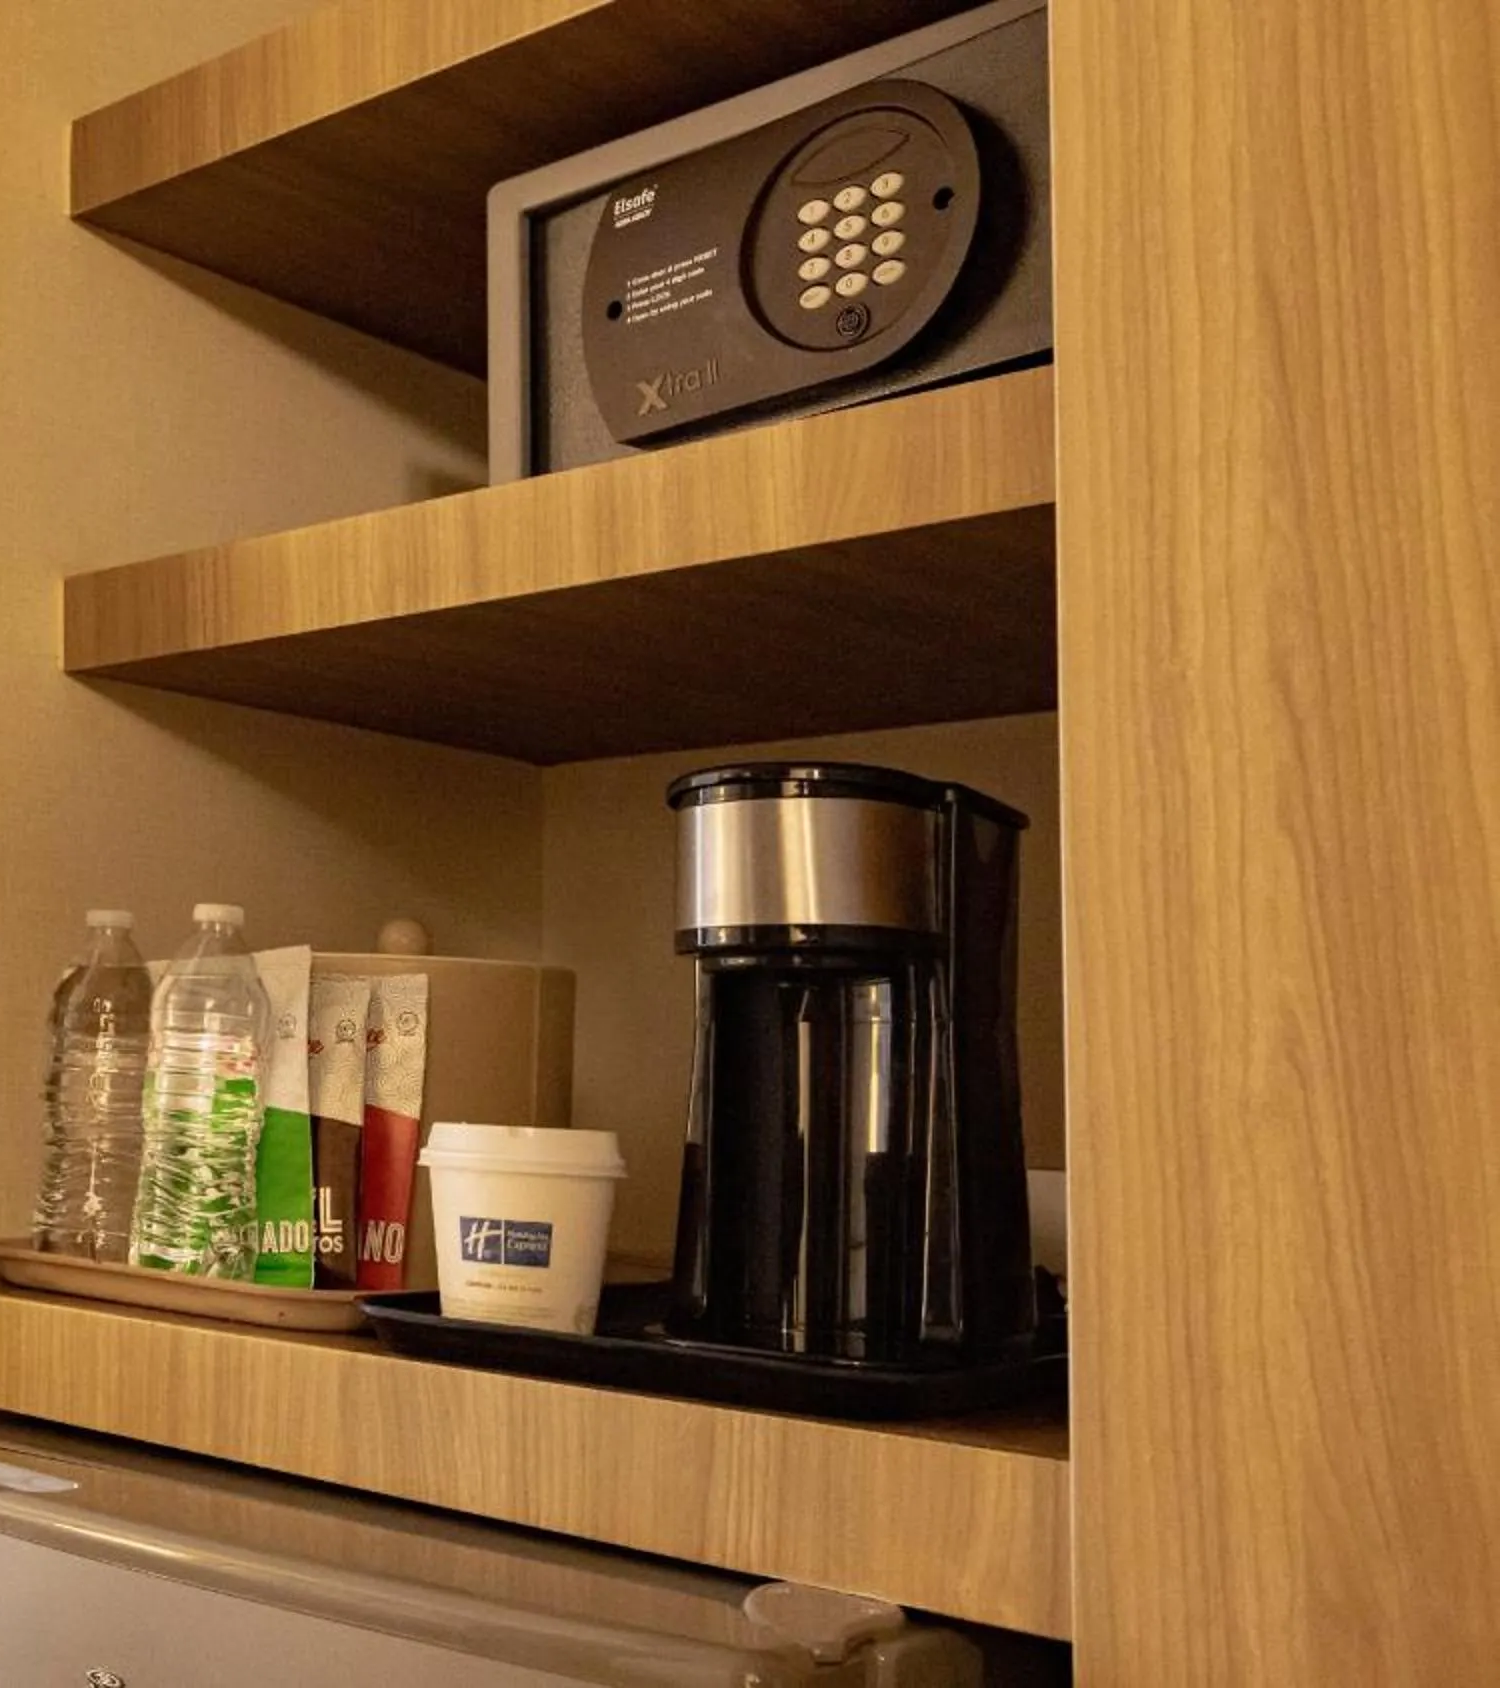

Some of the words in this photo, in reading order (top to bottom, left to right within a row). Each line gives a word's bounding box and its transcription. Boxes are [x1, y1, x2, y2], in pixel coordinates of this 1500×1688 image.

[614, 188, 655, 215] Elsafe
[261, 1218, 310, 1253] ADO
[358, 1219, 405, 1264] NO
